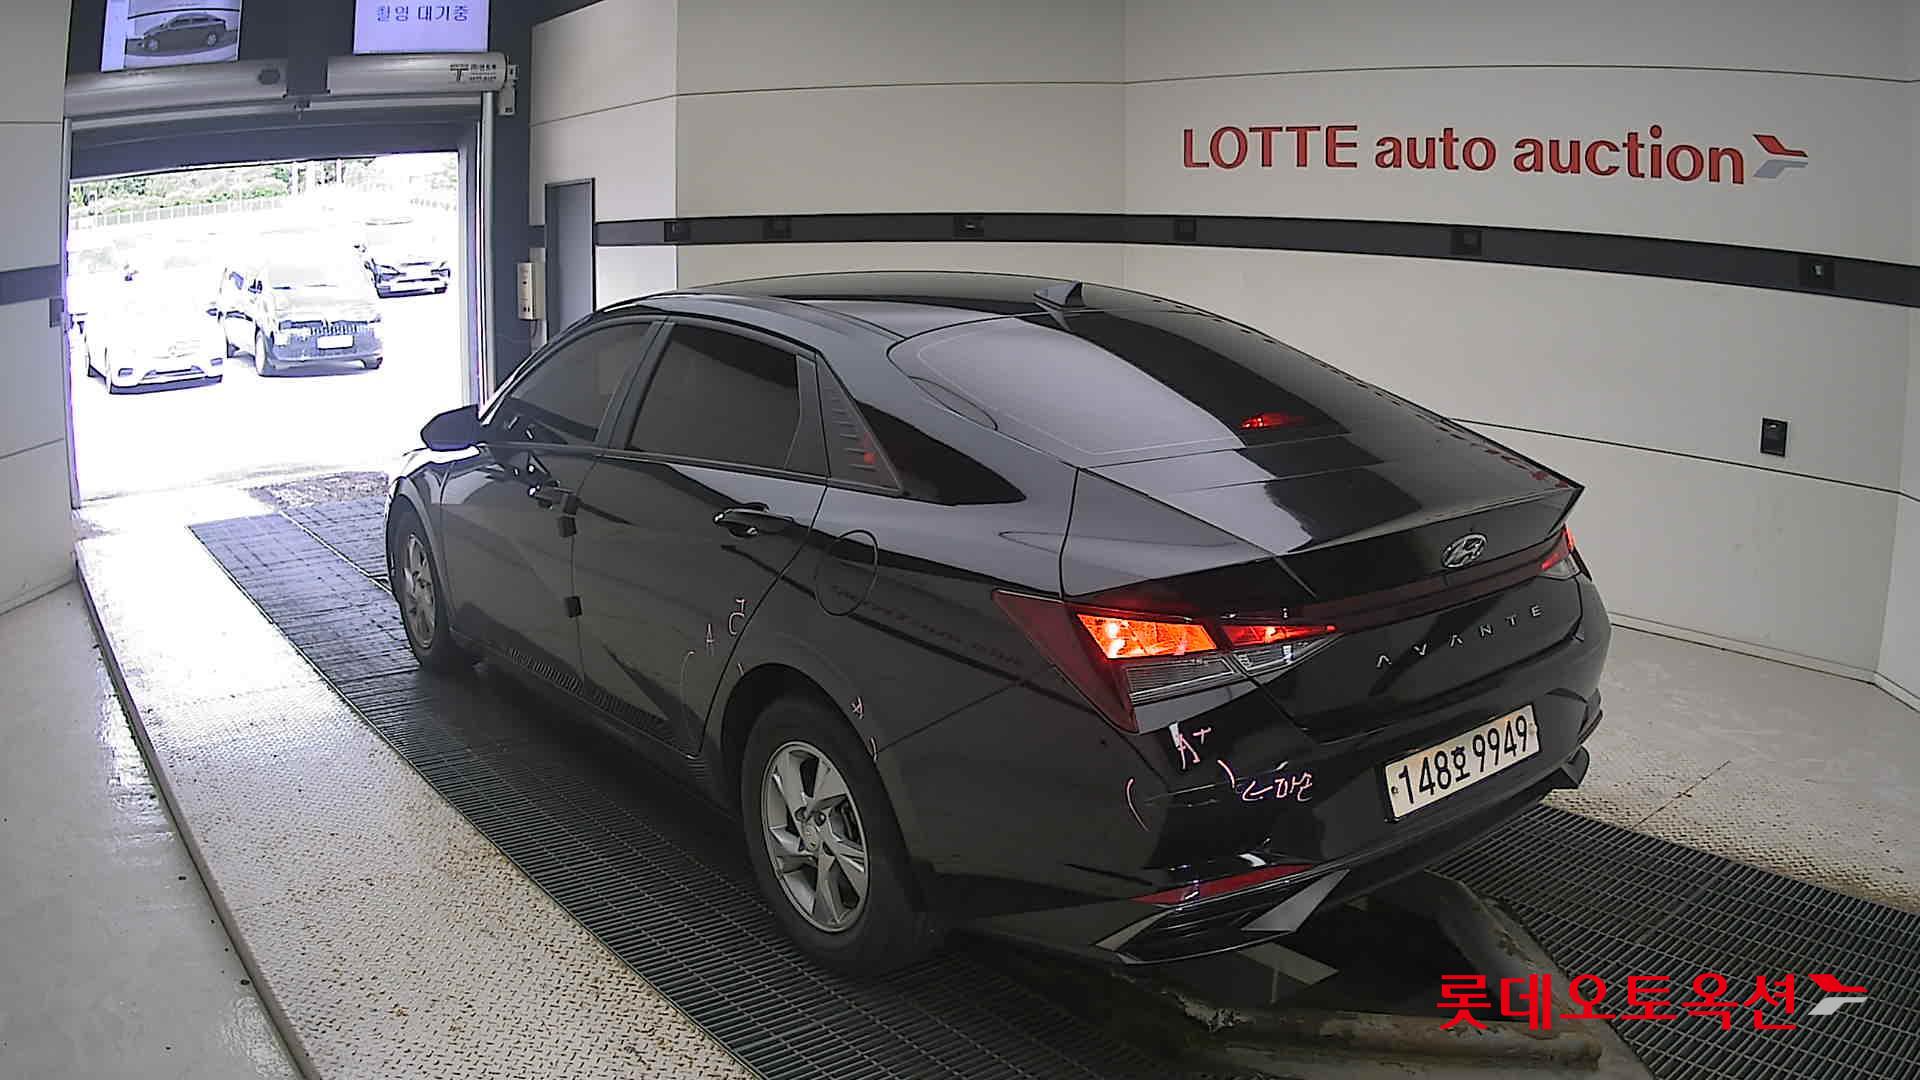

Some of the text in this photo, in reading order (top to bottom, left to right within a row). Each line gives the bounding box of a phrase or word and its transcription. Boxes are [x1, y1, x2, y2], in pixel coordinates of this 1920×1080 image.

[417, 5, 469, 22] 대기중
[1183, 124, 1745, 185] LOTTE auto auction
[1376, 604, 1543, 668] AVANTE
[1398, 715, 1529, 804] 148호 9949
